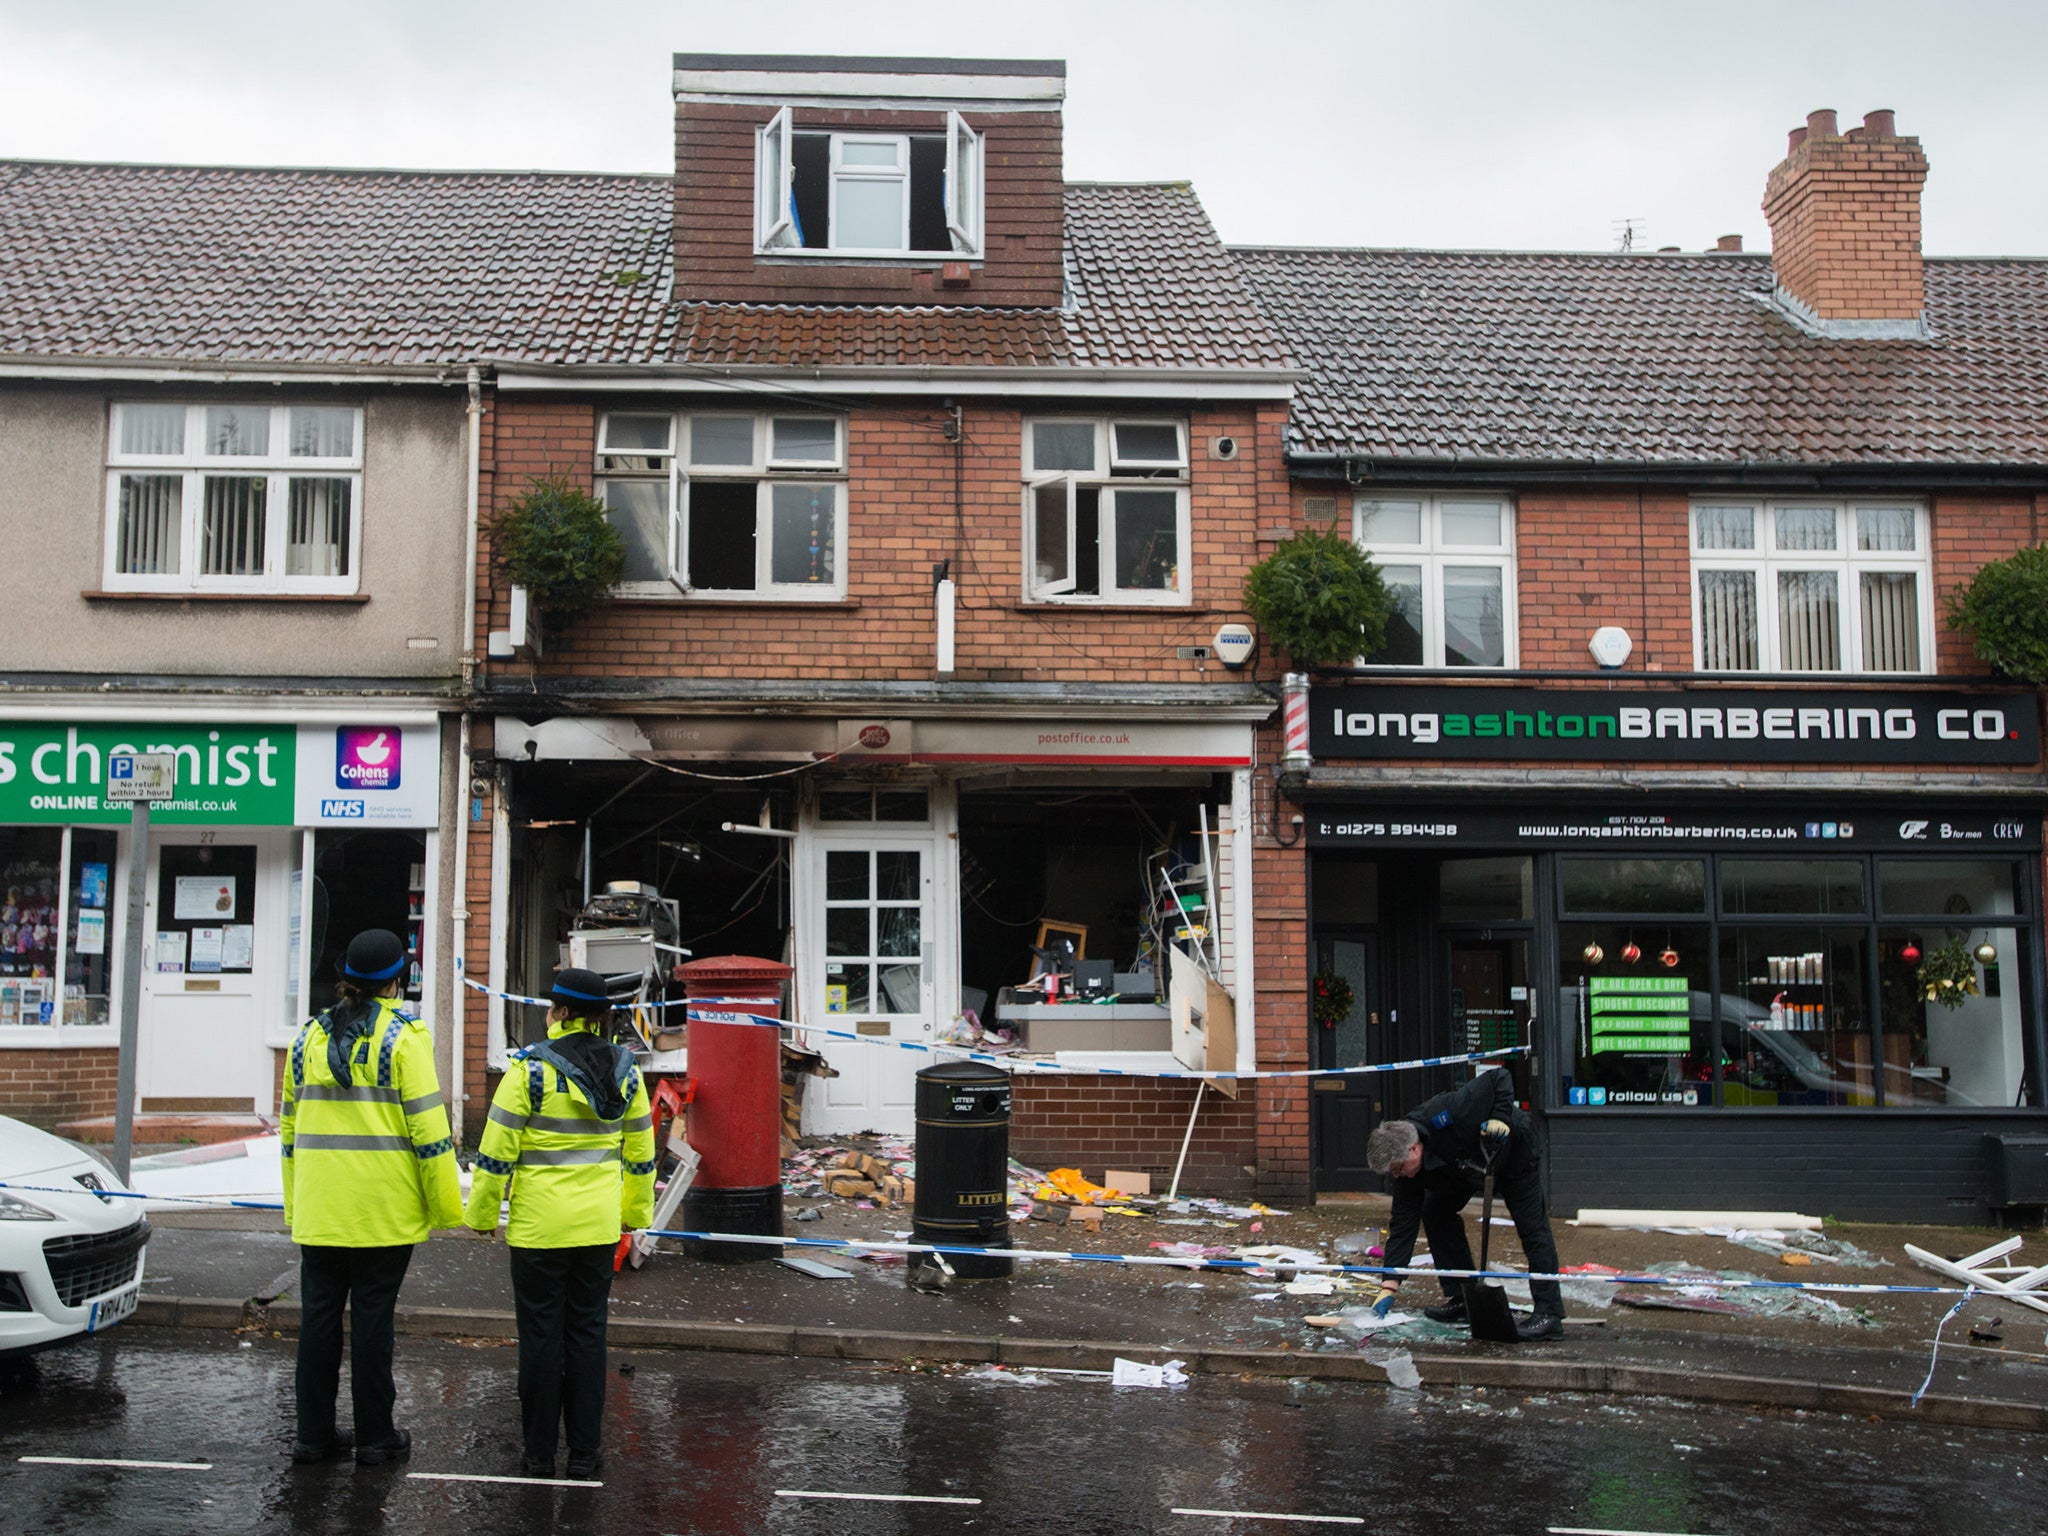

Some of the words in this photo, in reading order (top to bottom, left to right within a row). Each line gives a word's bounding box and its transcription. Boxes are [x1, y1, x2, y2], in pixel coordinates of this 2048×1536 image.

[1937, 708, 2018, 741] CO.
[664, 727, 700, 740] Office
[1038, 732, 1130, 745] postoffice.co.uk
[31, 727, 277, 787] chmist
[340, 764, 389, 778] Cohens
[361, 778, 388, 786] chemist
[30, 795, 98, 810] ONLINE
[323, 801, 362, 816] NHS
[1391, 824, 1457, 835] 394438
[1519, 825, 1797, 839] www.longashtonbarbering.co.uk
[1953, 830, 1964, 838] for
[1993, 823, 2023, 838] CREW
[201, 831, 215, 844] 27
[1594, 979, 1605, 989] WE
[1610, 979, 1625, 989] ARE
[1629, 979, 1651, 989] OPEN
[1664, 979, 1686, 989] DAYS
[1594, 998, 1633, 1009] STUDENT
[1637, 998, 1687, 1009] DISCOUNTS
[705, 1011, 735, 1022] POLICE
[1616, 1020, 1644, 1029] MONDAY
[1652, 1020, 1687, 1029] THURSDAY
[1595, 1039, 1615, 1049] LATE
[1618, 1039, 1642, 1049] NIGHT
[1646, 1039, 1689, 1049] THURSDAY
[1609, 1091, 1656, 1102] follow
[1662, 1092, 1682, 1102] us
[958, 1192, 1002, 1205] LITTER
